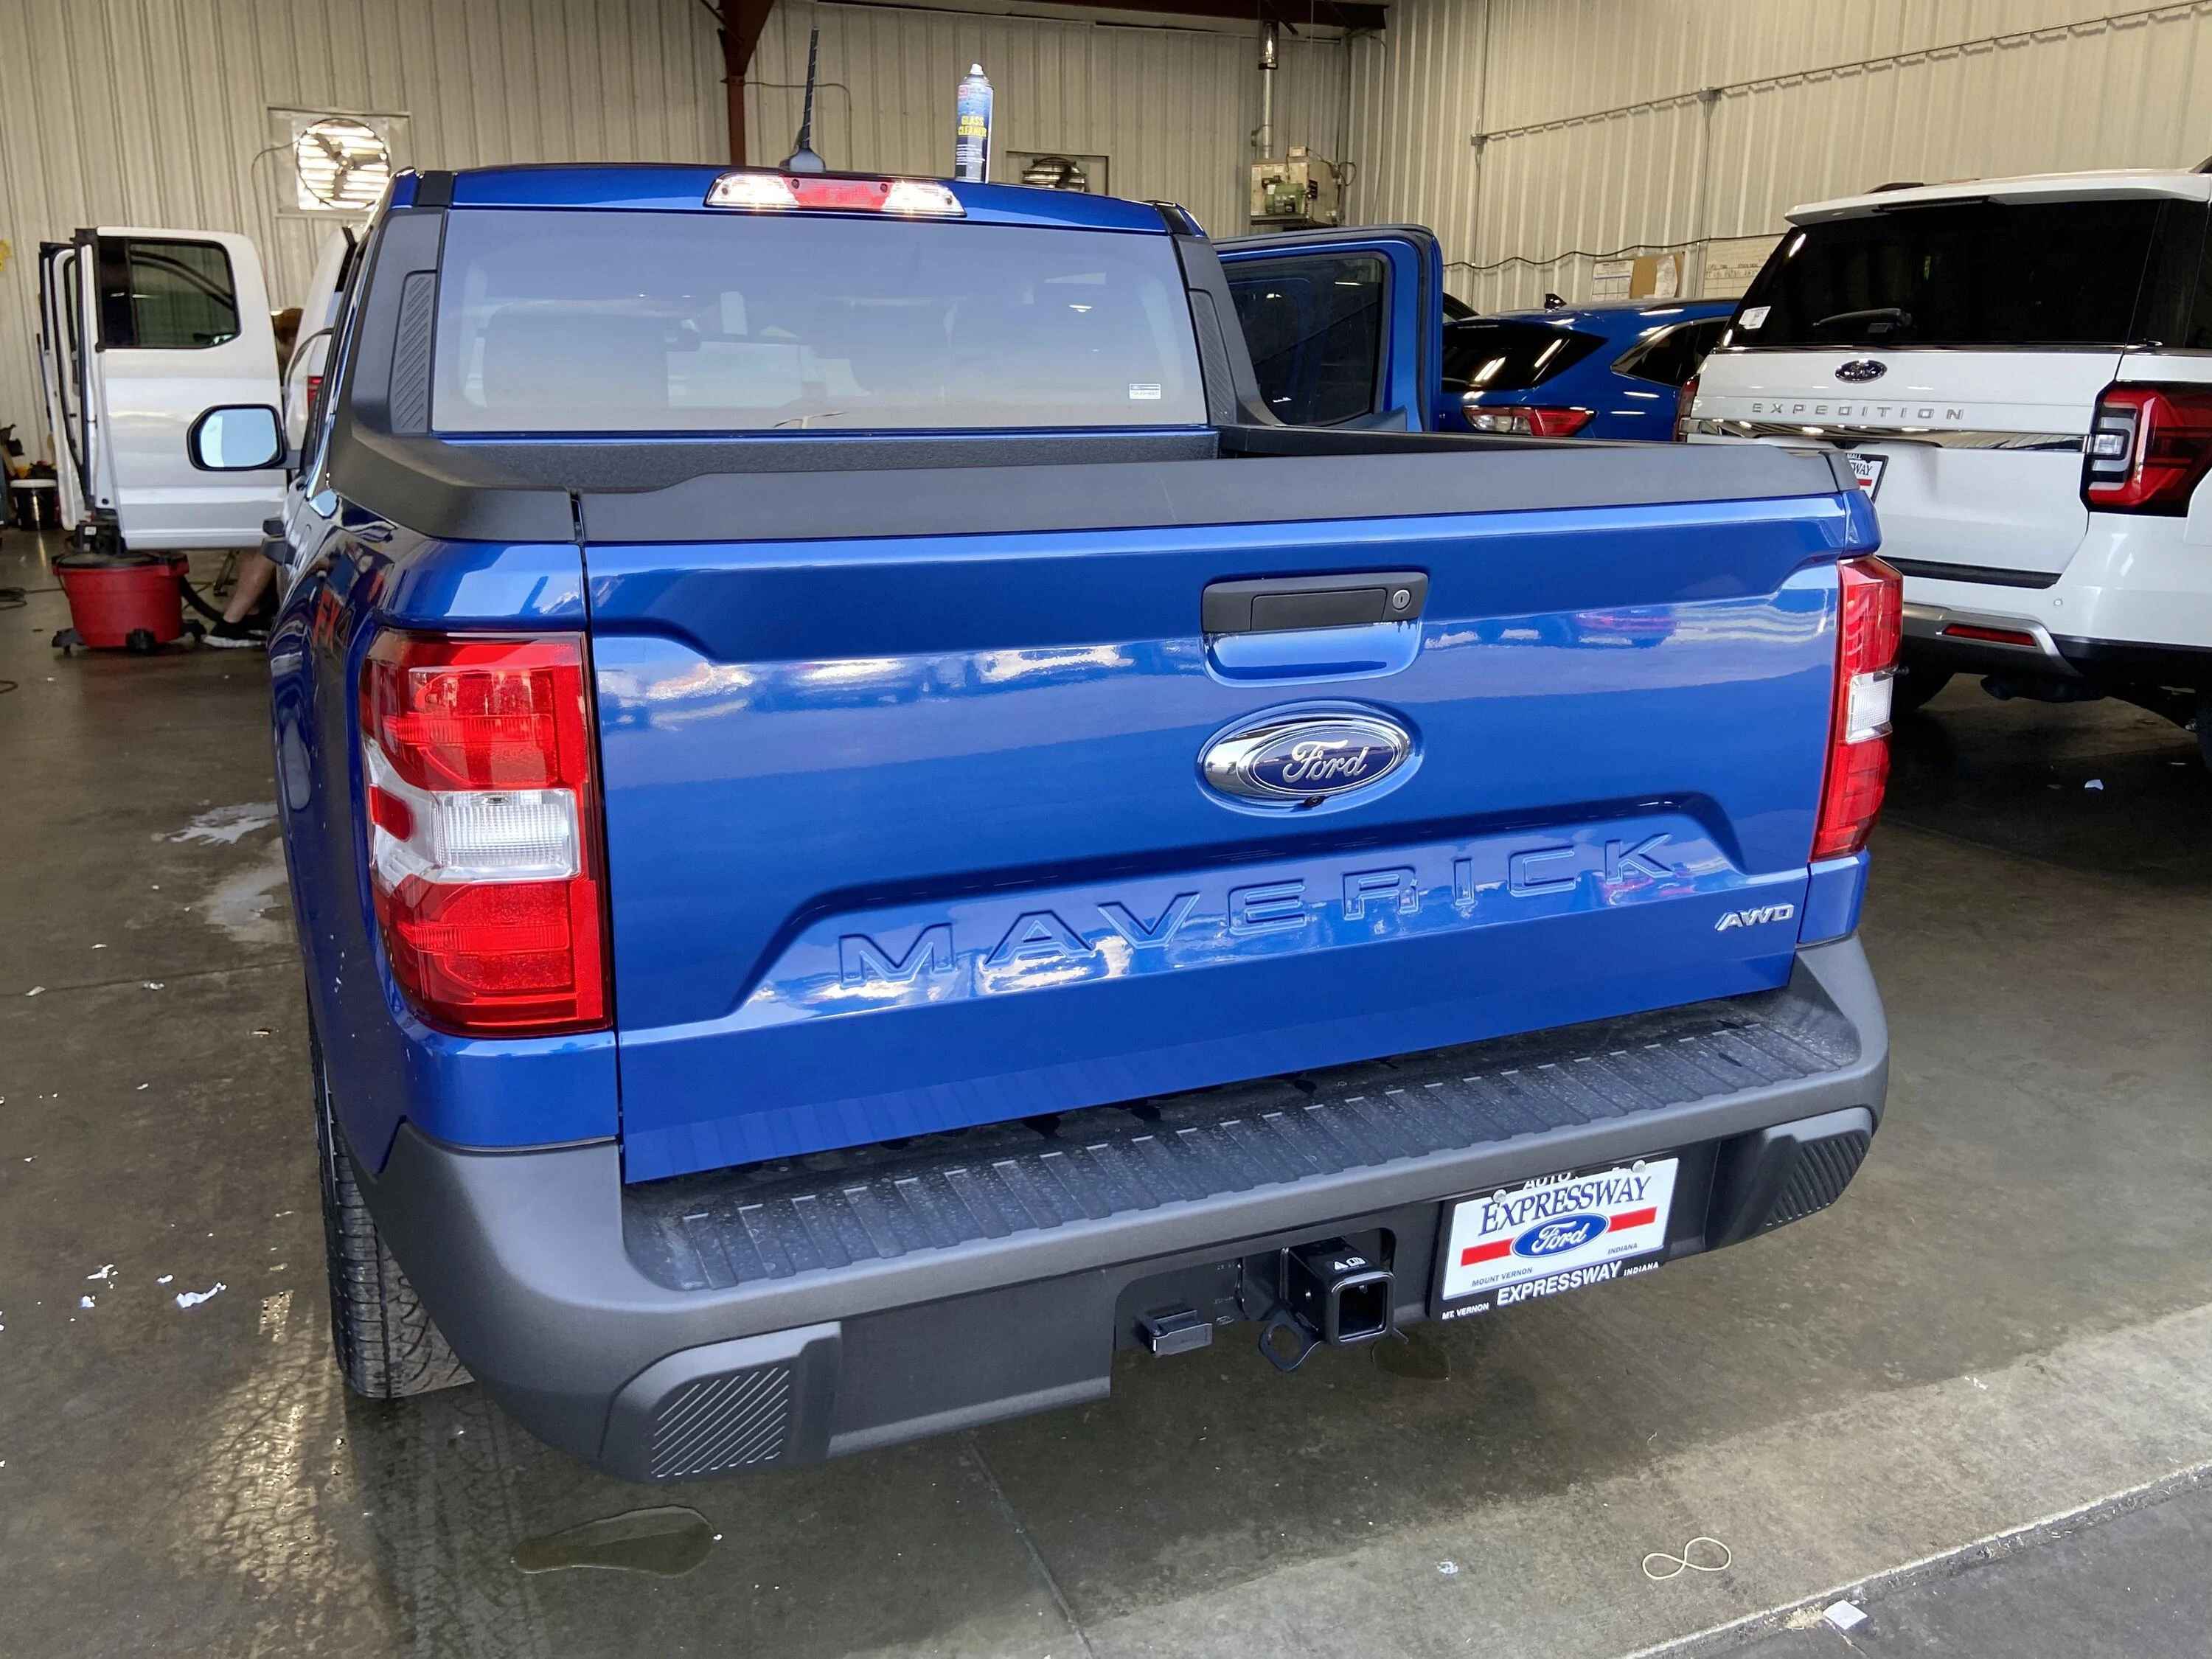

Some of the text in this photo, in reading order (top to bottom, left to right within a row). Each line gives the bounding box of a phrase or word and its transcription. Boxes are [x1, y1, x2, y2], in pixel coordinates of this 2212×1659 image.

[961, 115, 985, 126] GLASS
[1752, 403, 1964, 420] EXPEDITION
[1282, 739, 1369, 783] Ford
[838, 832, 1674, 990] MAVERICK
[1714, 903, 1795, 931] AWD
[1478, 1175, 1652, 1237] EXPRESSWAY
[1531, 1220, 1589, 1254] Ford
[1607, 1242, 1638, 1255] INDIANA
[1456, 1302, 1489, 1318] VERNON
[1496, 1260, 1622, 1307] EXPRESSWAY
[1623, 1261, 1659, 1277] INDIANA
[1472, 1267, 1533, 1287] MOUNT VERNON
